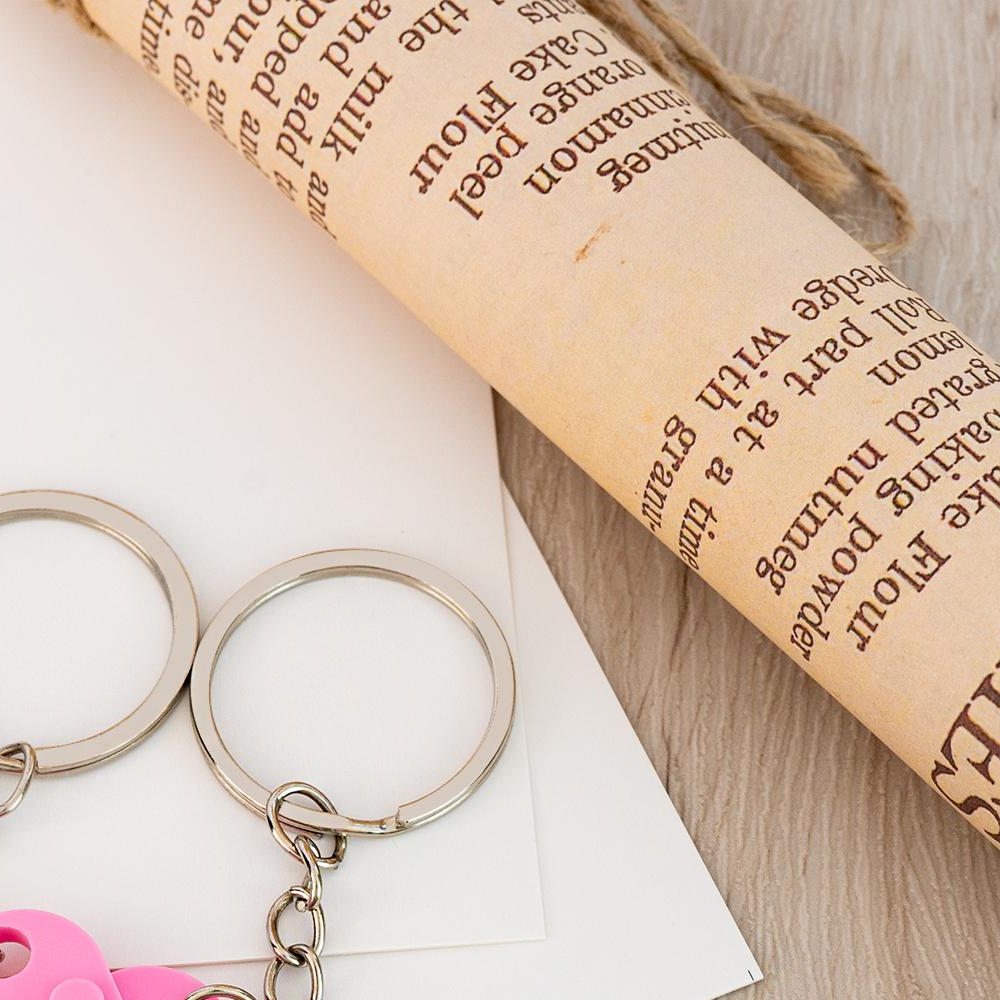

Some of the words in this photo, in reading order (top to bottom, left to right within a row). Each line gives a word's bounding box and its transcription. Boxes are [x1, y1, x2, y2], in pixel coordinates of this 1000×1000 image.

[250, 0, 336, 109] pped
[319, 0, 392, 79] and
[398, 0, 469, 53] the
[509, 29, 608, 82] Cake
[275, 81, 319, 169] add
[320, 61, 393, 162] milk
[529, 58, 646, 128] orange
[409, 80, 517, 195] Flour
[449, 121, 528, 221] peel
[595, 121, 731, 194] nutmeg
[870, 295, 948, 336] Roll
[694, 326, 790, 412] with
[783, 316, 873, 397] part
[866, 329, 983, 388] lemon
[733, 400, 779, 453] at
[884, 357, 1000, 447] grated
[705, 457, 733, 486] a
[678, 497, 717, 571] time
[755, 438, 888, 596] nutmeg
[790, 512, 882, 661] powder
[846, 530, 951, 653] Flour
